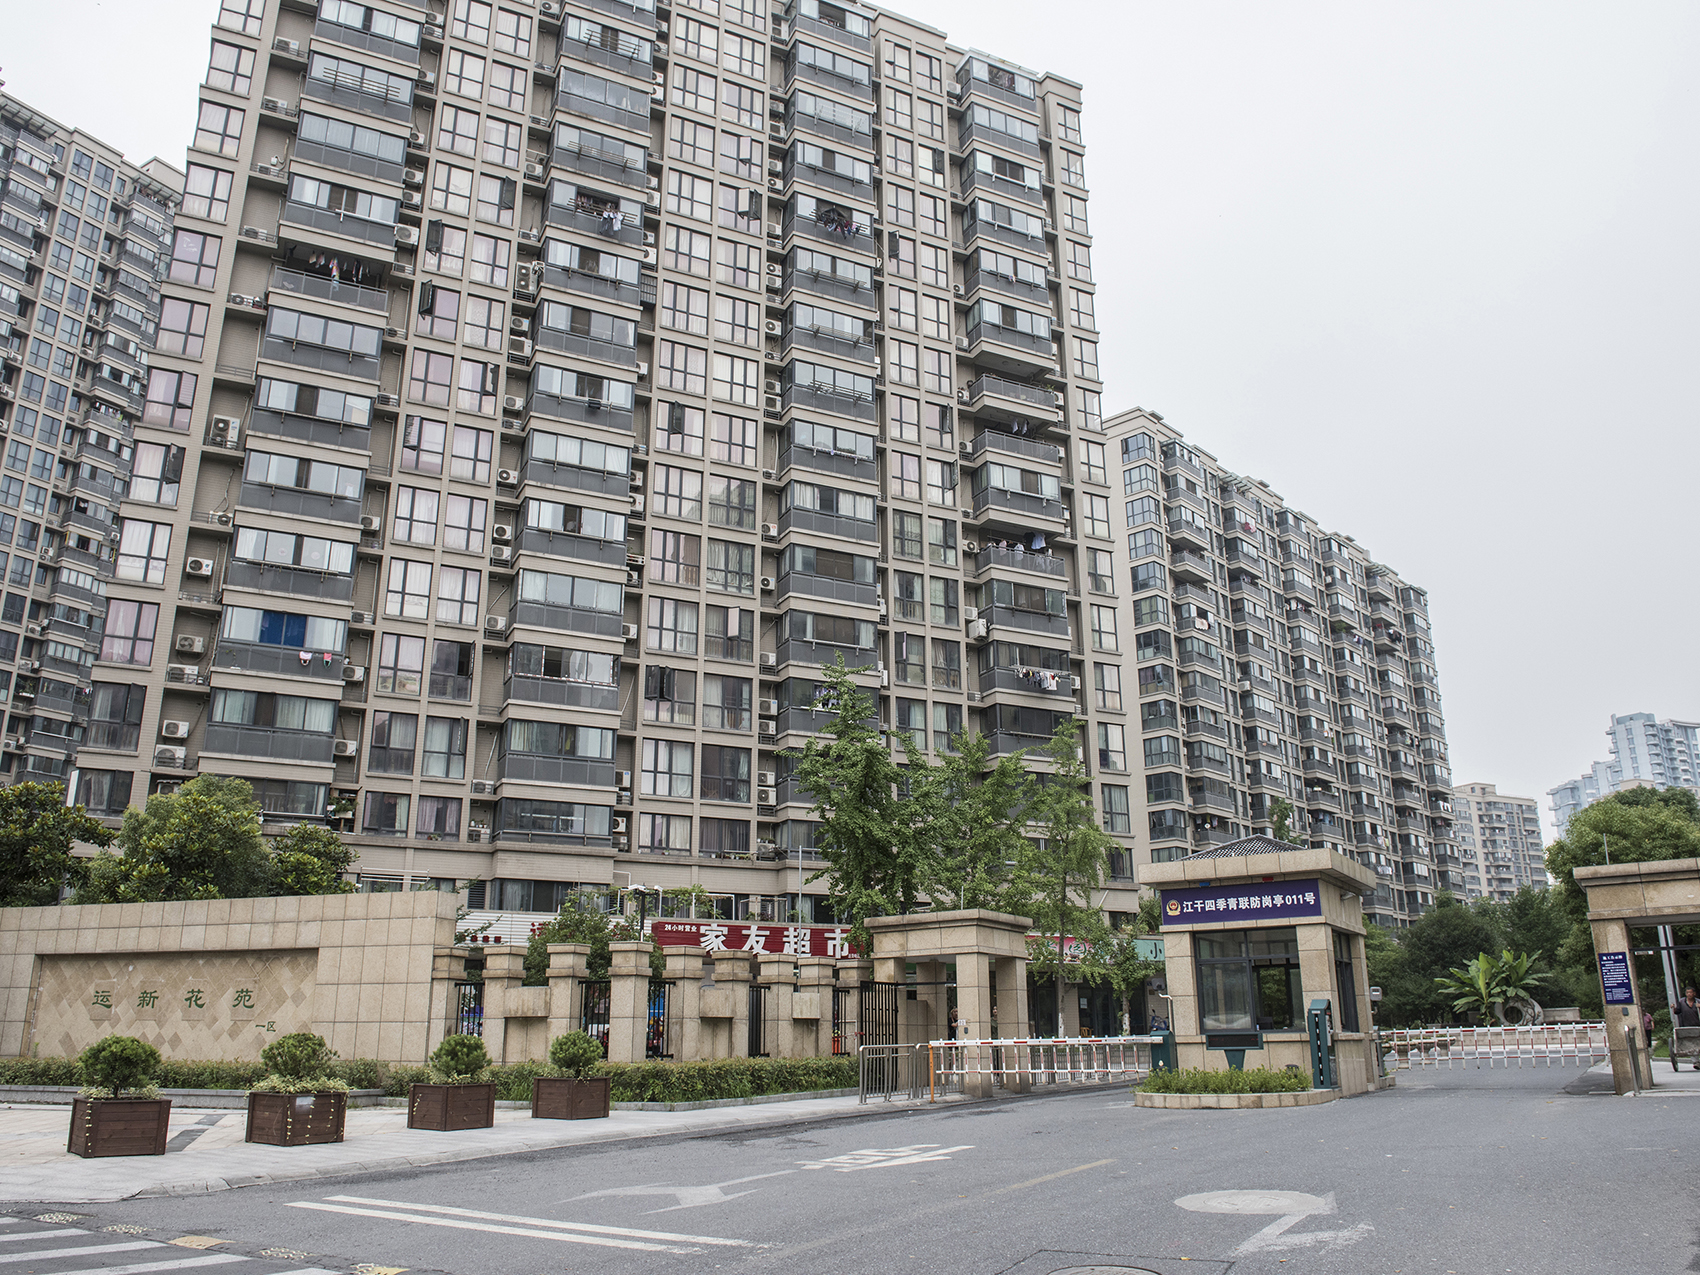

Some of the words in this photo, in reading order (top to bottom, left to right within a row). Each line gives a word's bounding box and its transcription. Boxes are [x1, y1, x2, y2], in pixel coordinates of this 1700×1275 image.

[1182, 891, 1316, 913] 江干四季青联防岗亭011号
[664, 923, 698, 932] 24小时营业
[699, 923, 849, 959] 家友超市
[91, 988, 256, 1009] 运新花苑
[255, 1021, 277, 1032] 一区
